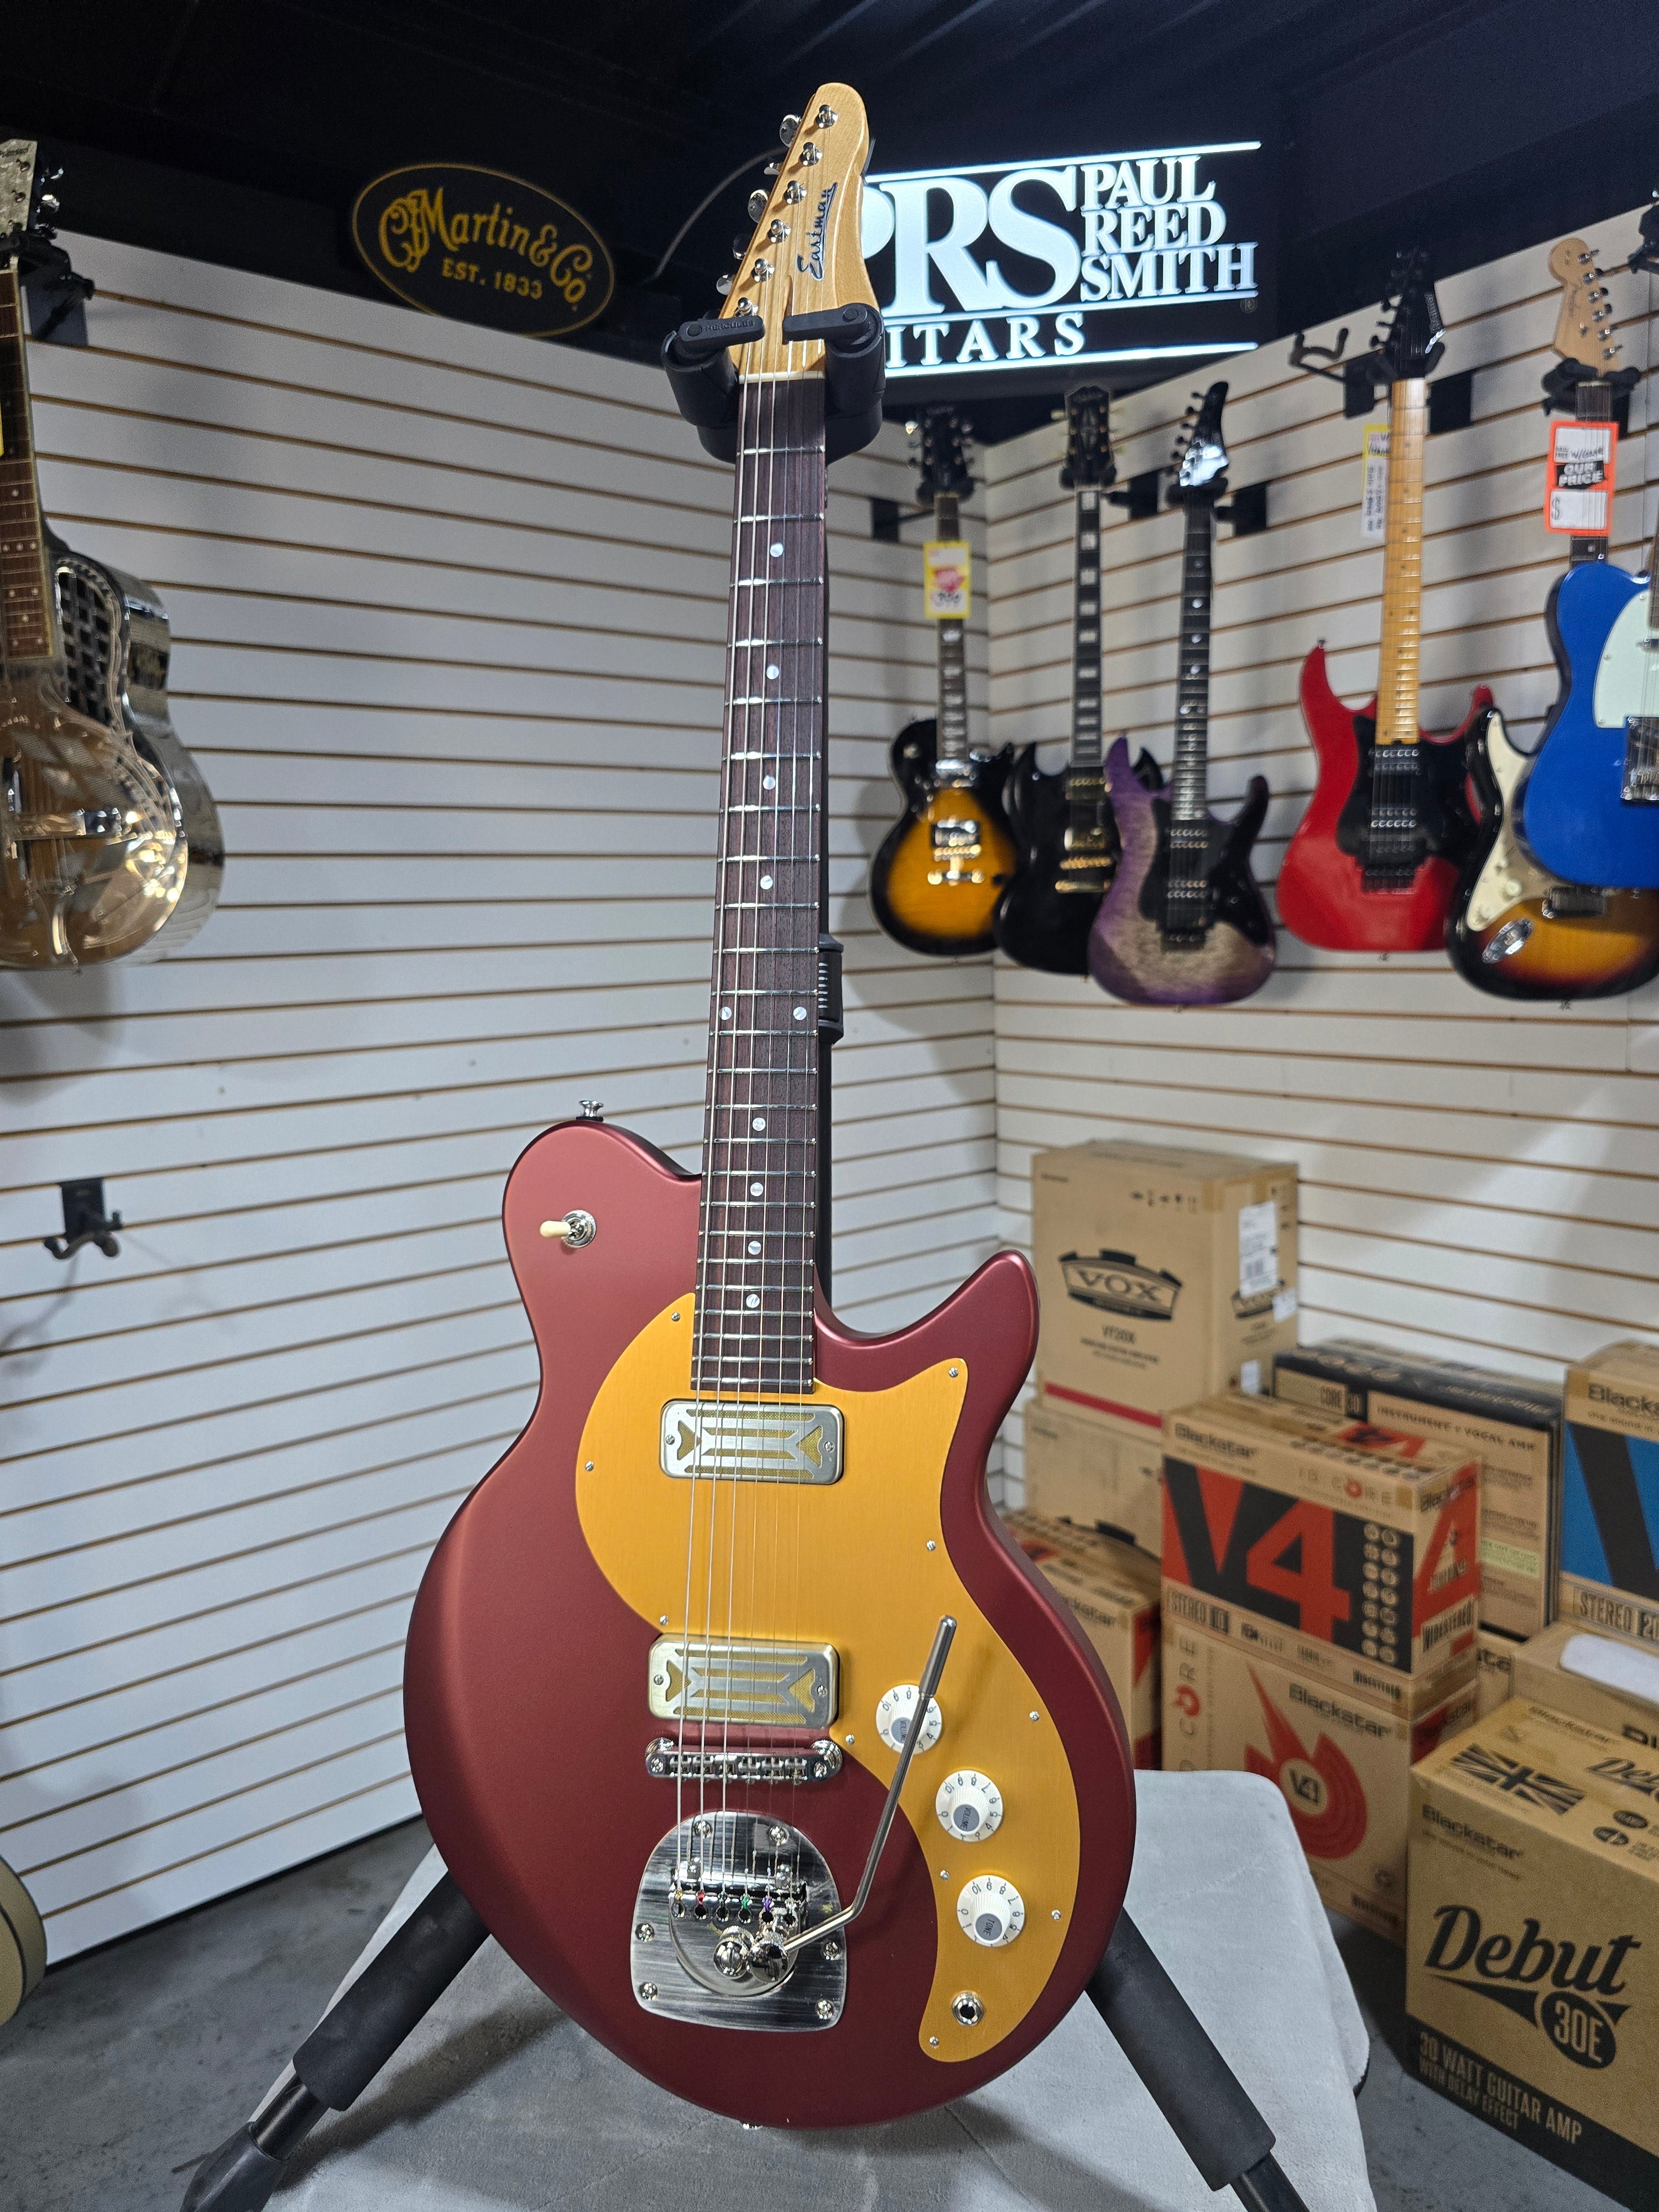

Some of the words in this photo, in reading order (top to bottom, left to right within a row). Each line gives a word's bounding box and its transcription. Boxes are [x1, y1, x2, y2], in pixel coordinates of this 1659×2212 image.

[1080, 155, 1215, 211] PAUL
[796, 182, 838, 281] Eastman
[1080, 201, 1227, 258] REED
[442, 257, 486, 286] EST.
[494, 271, 543, 300] 1833
[1080, 242, 1259, 302] SMITH
[1558, 470, 1604, 487] PRICE
[1564, 462, 1597, 475] OUR
[1077, 1271, 1159, 1302] VOX
[1174, 1422, 1257, 1459] Blackstar
[1163, 1455, 1351, 1644] V4
[1580, 1590, 1632, 1635] STEREO
[1288, 1683, 1391, 1738] Blackstar
[1288, 1768, 1319, 1804] V4
[960, 1806, 972, 1830] VOLUME
[1422, 1803, 1525, 1860] Blackstar
[983, 1918, 995, 1936] TONE
[1425, 1904, 1642, 1996] Debut
[1553, 1999, 1604, 2064] 30E
[1442, 2043, 1484, 2088] WATT
[1487, 2070, 1542, 2125] GUITAR
[1546, 2107, 1583, 2145] AMP
[1481, 2094, 1519, 2130] EFFECT
